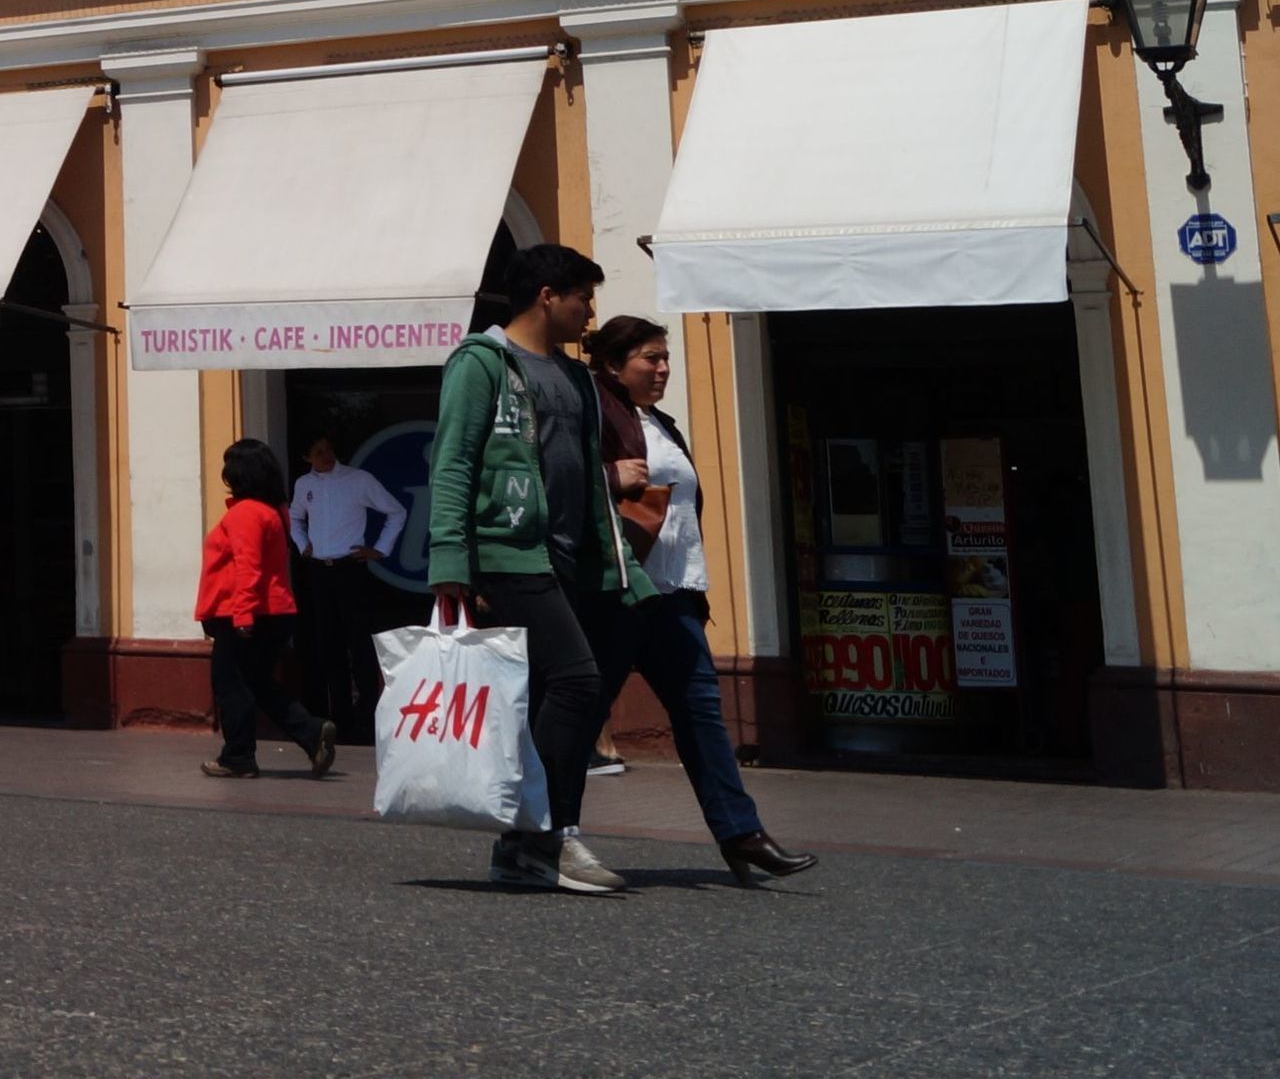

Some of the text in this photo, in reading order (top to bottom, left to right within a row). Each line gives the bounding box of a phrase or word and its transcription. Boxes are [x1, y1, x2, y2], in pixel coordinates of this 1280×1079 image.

[1189, 229, 1227, 249] ADT
[140, 323, 463, 354] TURISTIK CAFE INFOCENTER
[507, 476, 529, 499] N
[968, 607, 992, 616] GRAN
[960, 619, 1002, 628] VARIEDAD
[958, 631, 1006, 641] DE QUESOS
[956, 643, 1009, 653] NACIONALES
[980, 656, 986, 665] E
[957, 668, 1011, 678] IMPORTADOS
[394, 677, 491, 750] H&M
